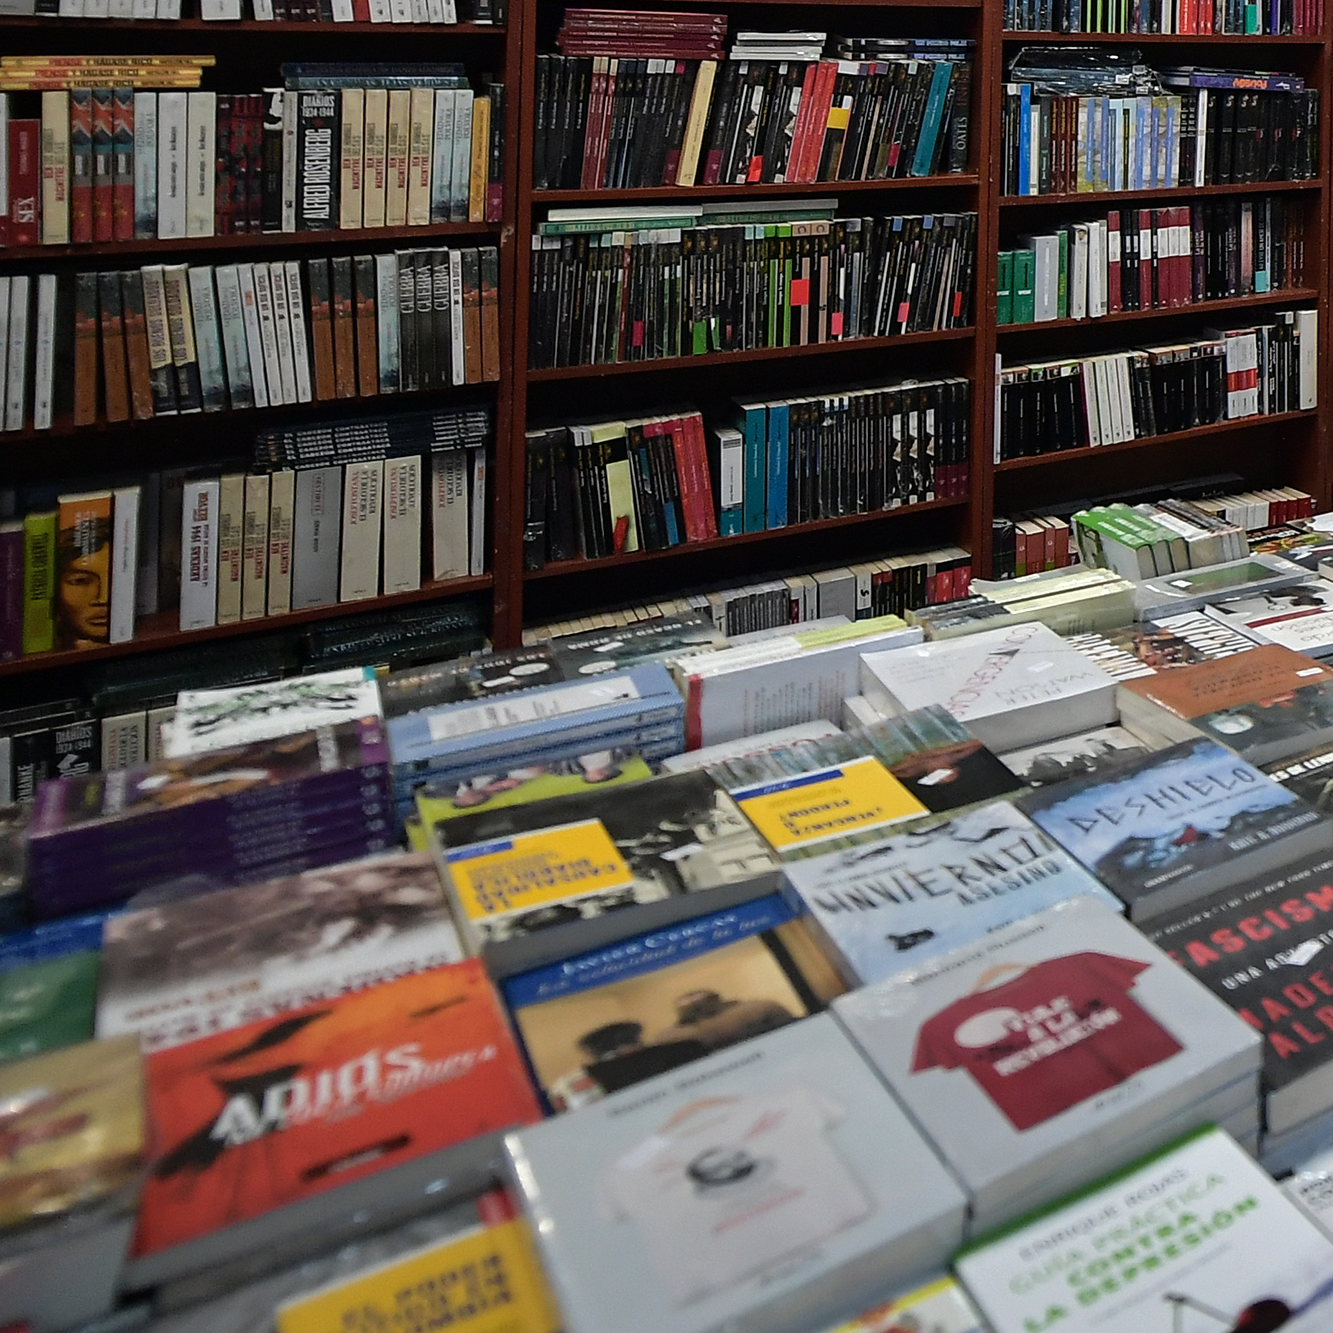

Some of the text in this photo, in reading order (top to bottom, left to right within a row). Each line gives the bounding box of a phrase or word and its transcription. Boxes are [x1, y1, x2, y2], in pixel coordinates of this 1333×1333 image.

[302, 94, 336, 107] DIARIOS
[954, 116, 967, 150] OATES
[303, 128, 332, 219] ALFRED ROSENBERG
[400, 265, 415, 314] GUERRA
[416, 264, 432, 313] GUERRA
[433, 262, 449, 311] GUERRA
[1221, 966, 1263, 991] UNA
